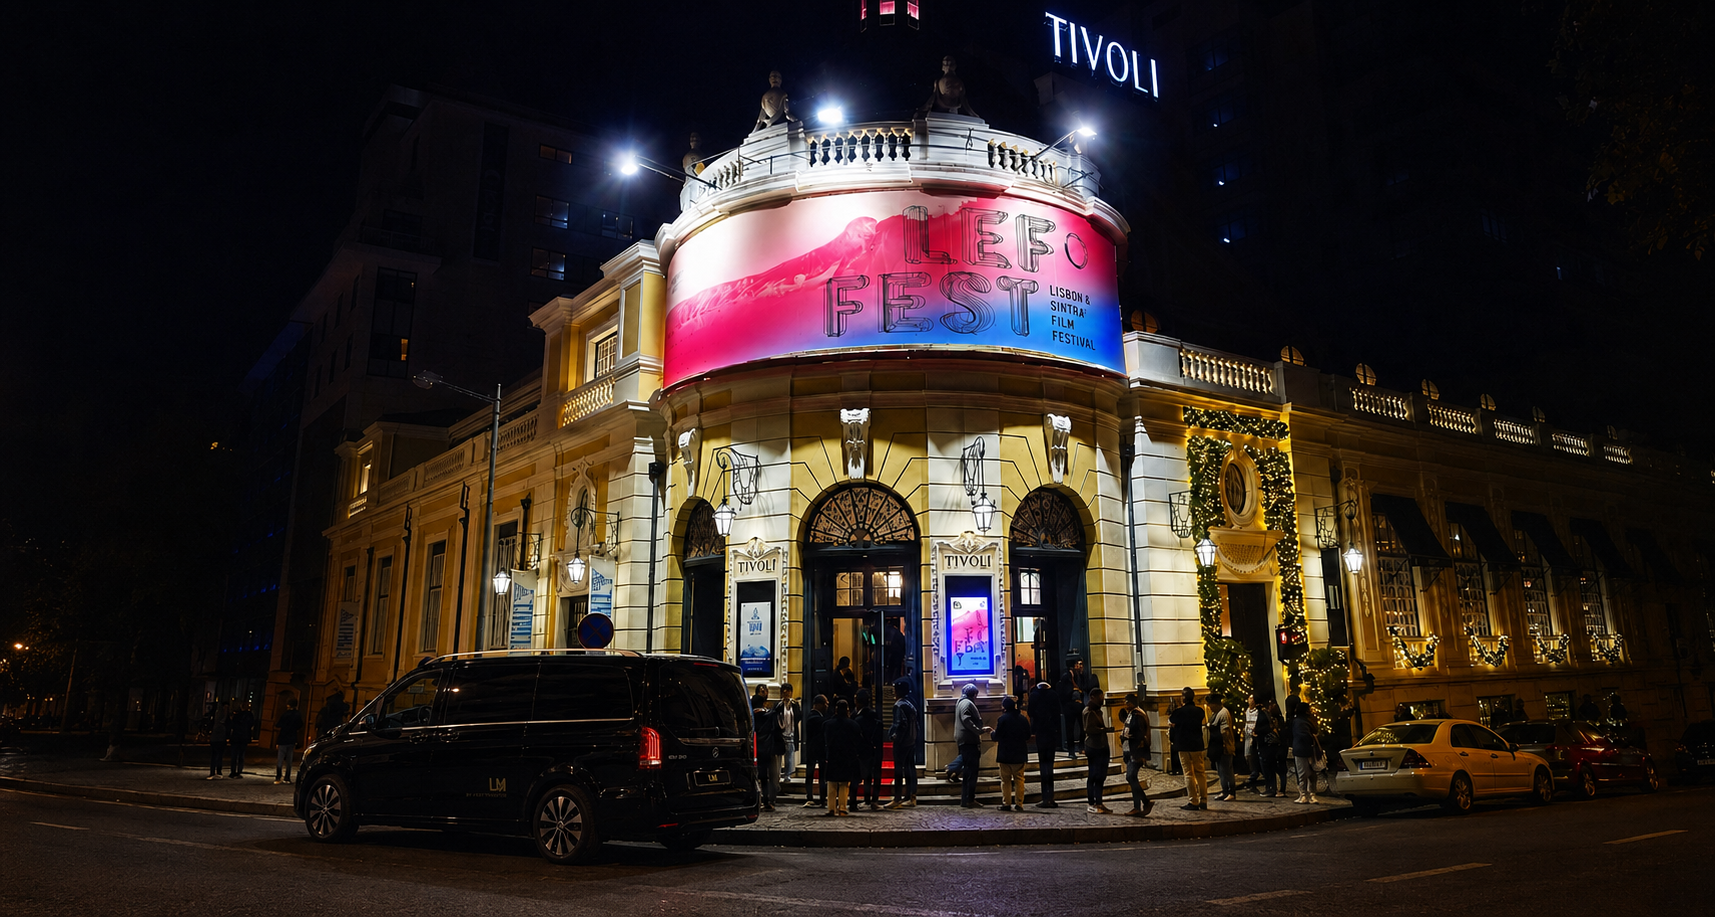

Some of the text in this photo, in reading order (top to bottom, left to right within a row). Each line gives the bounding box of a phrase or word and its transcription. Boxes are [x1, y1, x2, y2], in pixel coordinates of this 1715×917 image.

[1045, 11, 1158, 98] TIVOLI
[823, 271, 1040, 337] FEST
[1049, 285, 1091, 306] LISBON &
[1051, 315, 1075, 330] FILM
[1052, 330, 1096, 351] FESTIVAL
[738, 559, 776, 573] TIVOLI
[944, 555, 991, 567] TIVOLI
[489, 777, 507, 792] LM
